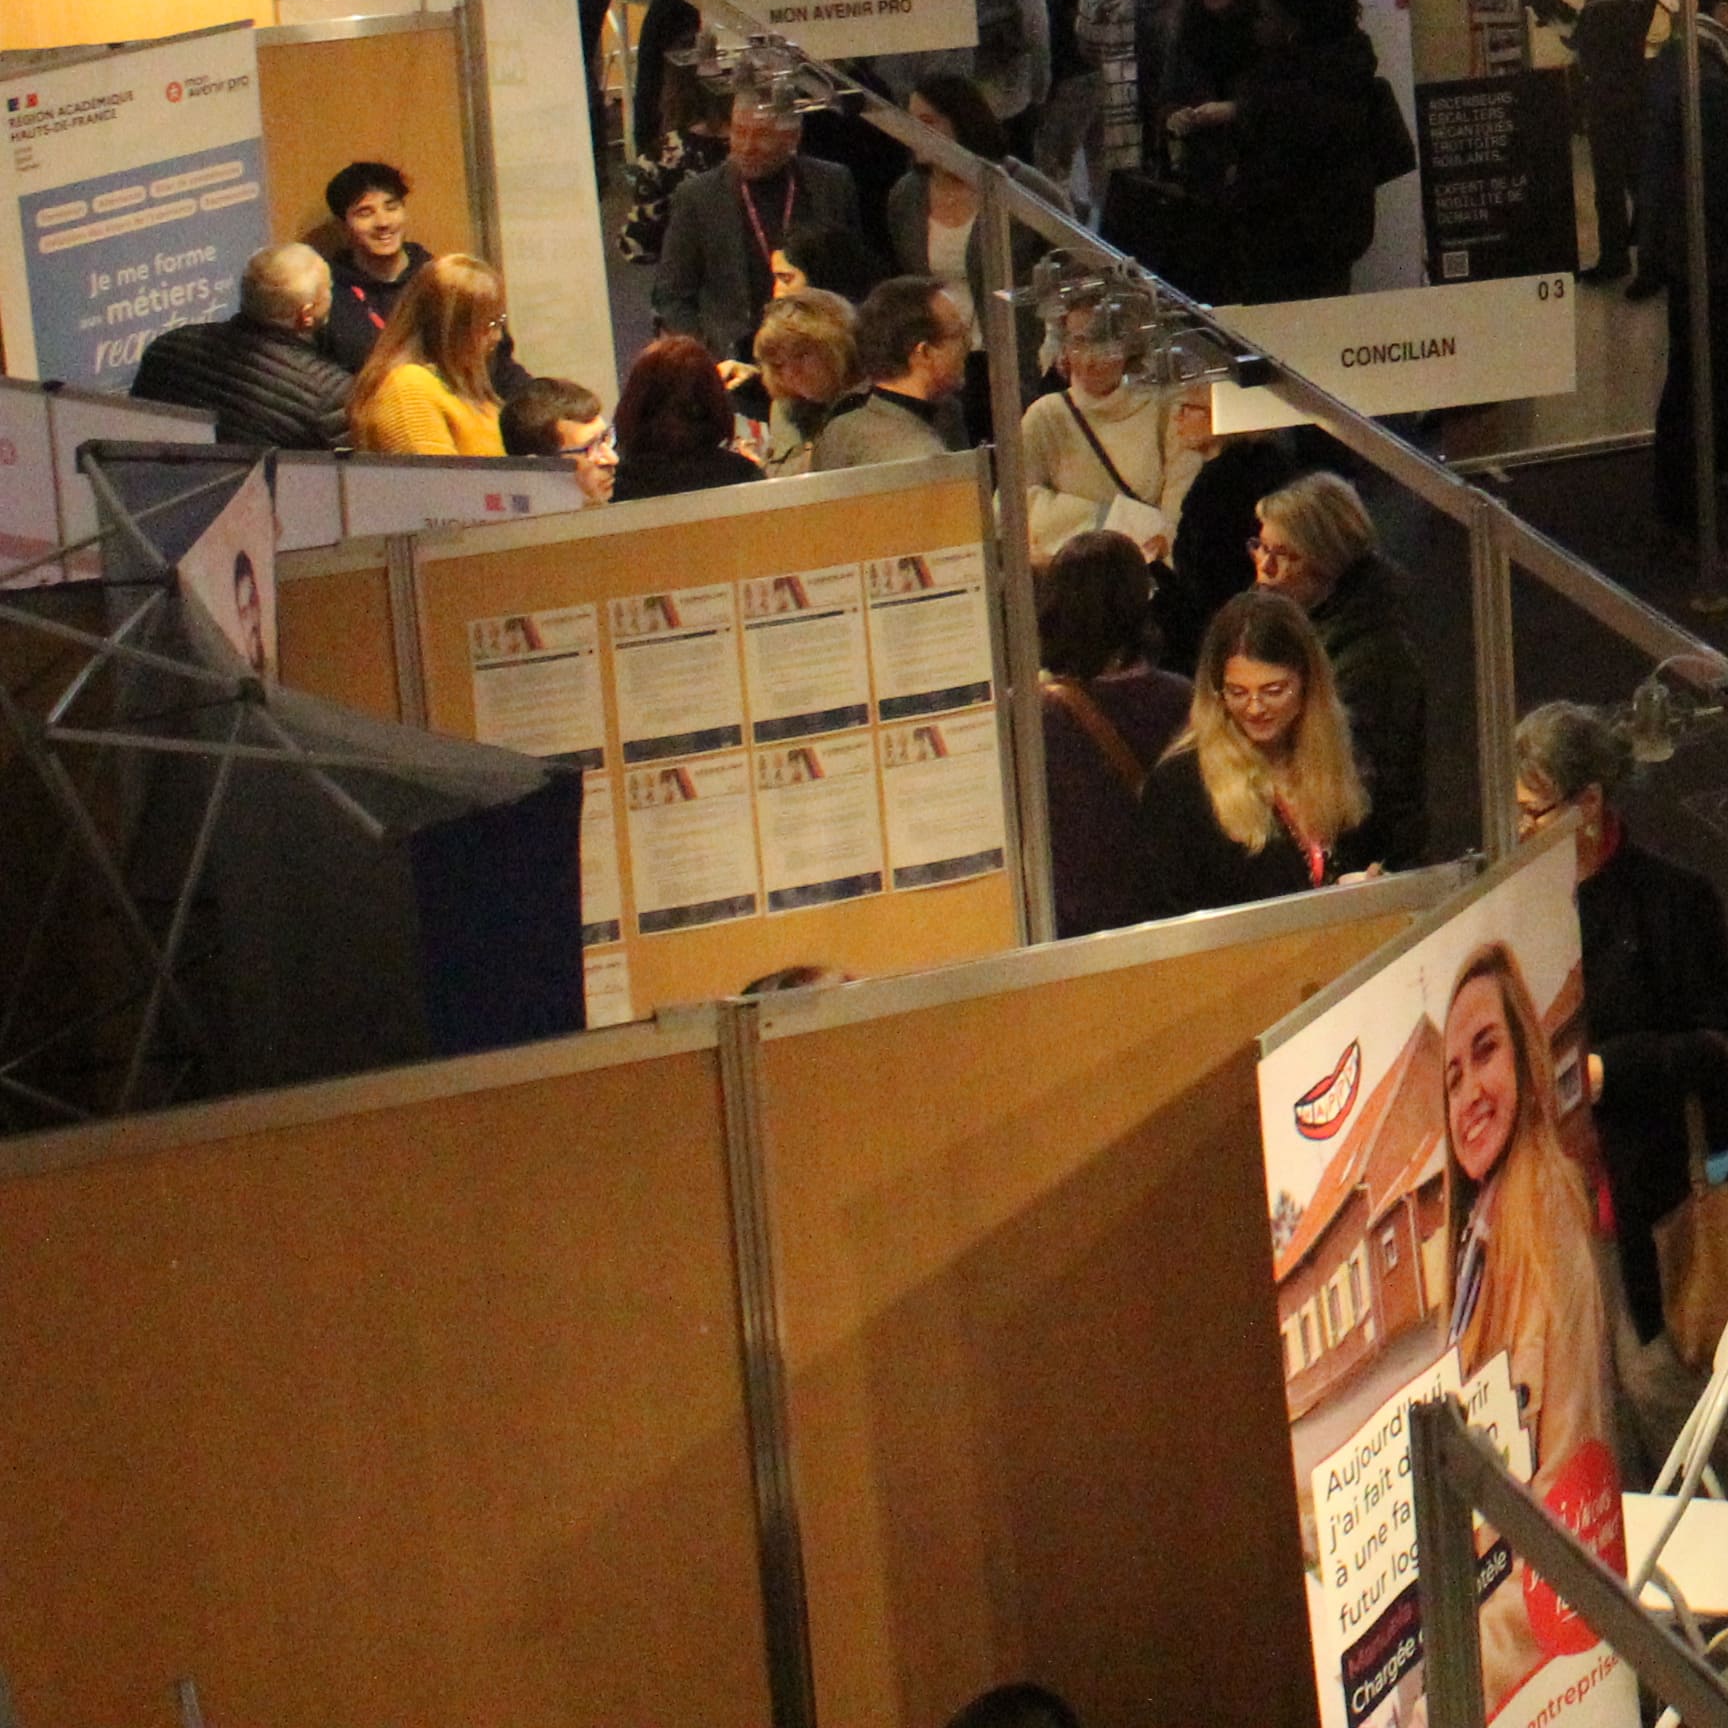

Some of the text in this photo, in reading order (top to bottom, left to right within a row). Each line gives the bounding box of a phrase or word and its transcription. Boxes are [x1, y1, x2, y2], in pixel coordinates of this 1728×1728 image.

[769, 7, 808, 23] MON
[813, 1, 873, 20] AVENIR
[90, 245, 217, 299] Je me forme
[1538, 278, 1566, 301] 03
[106, 275, 211, 326] métiers
[1340, 337, 1457, 369] CONCILIAN
[1328, 1469, 1402, 1556] j'ai fait
[1335, 1560, 1350, 1590] à
[1353, 1527, 1389, 1572] une
[1338, 1572, 1387, 1636] futur
[1390, 1544, 1420, 1584] log
[1351, 1636, 1417, 1715] Chargée
